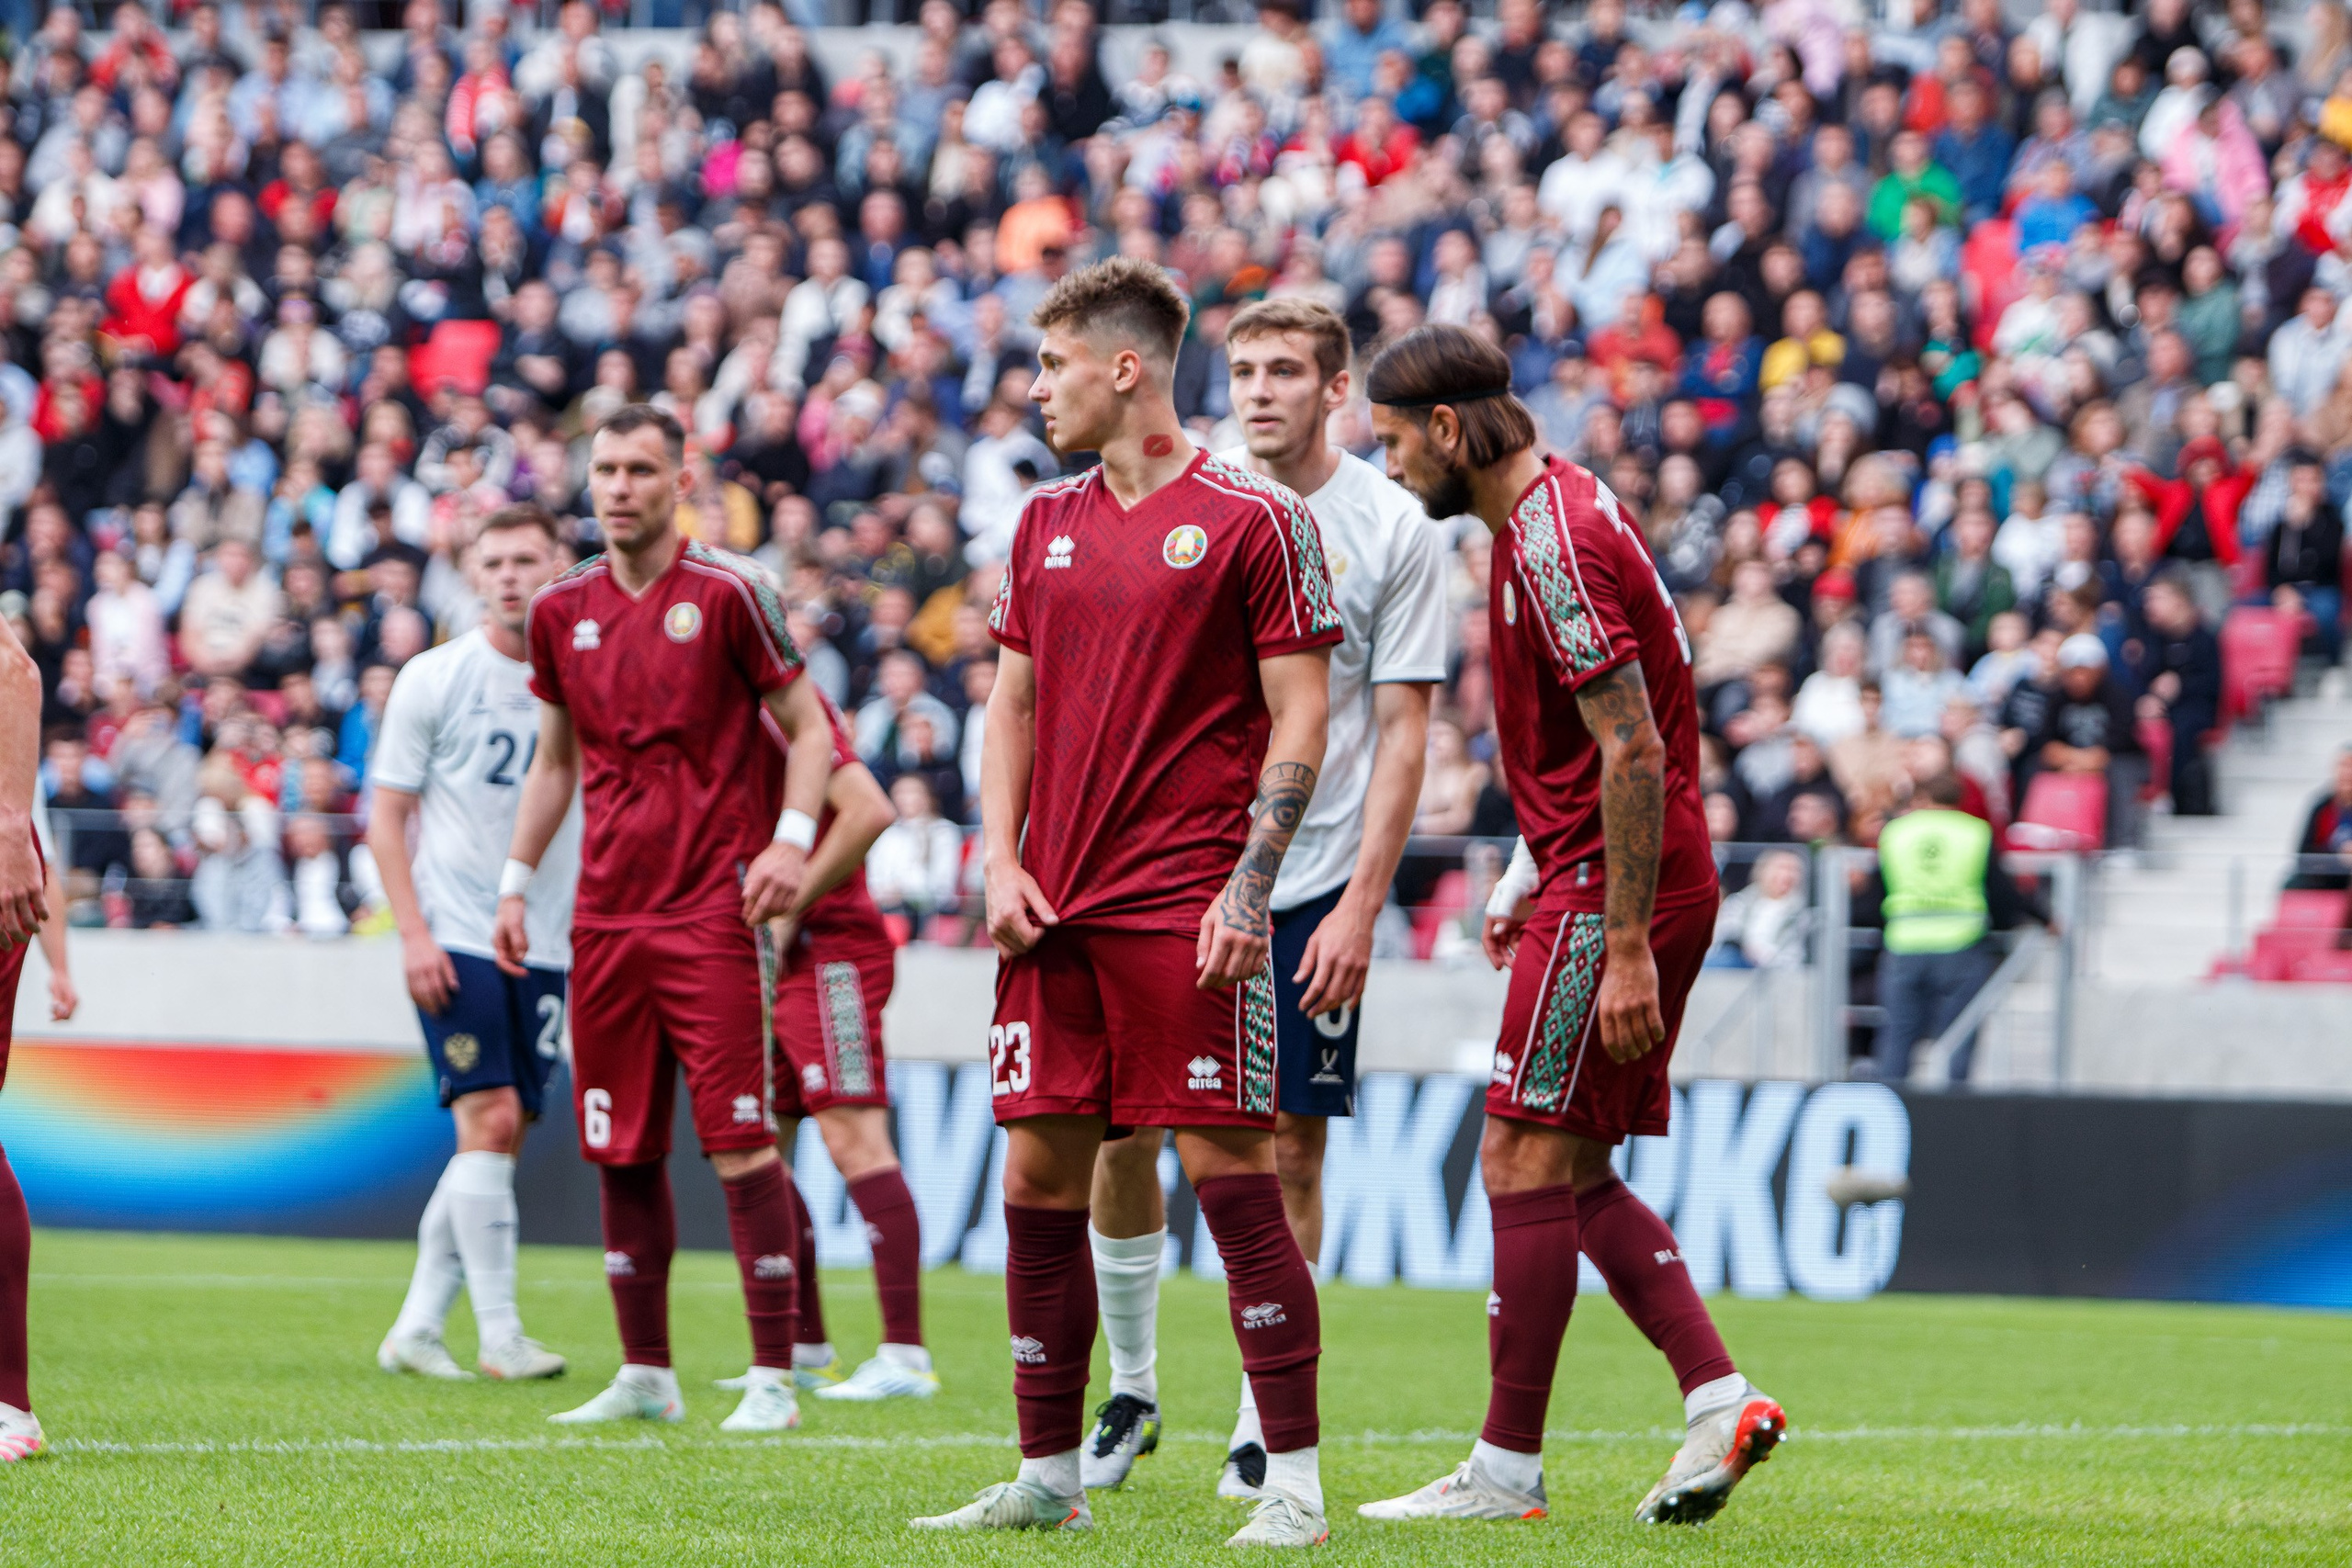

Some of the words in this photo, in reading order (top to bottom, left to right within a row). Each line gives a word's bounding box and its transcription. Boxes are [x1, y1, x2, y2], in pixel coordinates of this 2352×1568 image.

[484, 728, 538, 786] 2
[989, 1021, 1031, 1096] 23
[583, 1088, 613, 1148] 6
